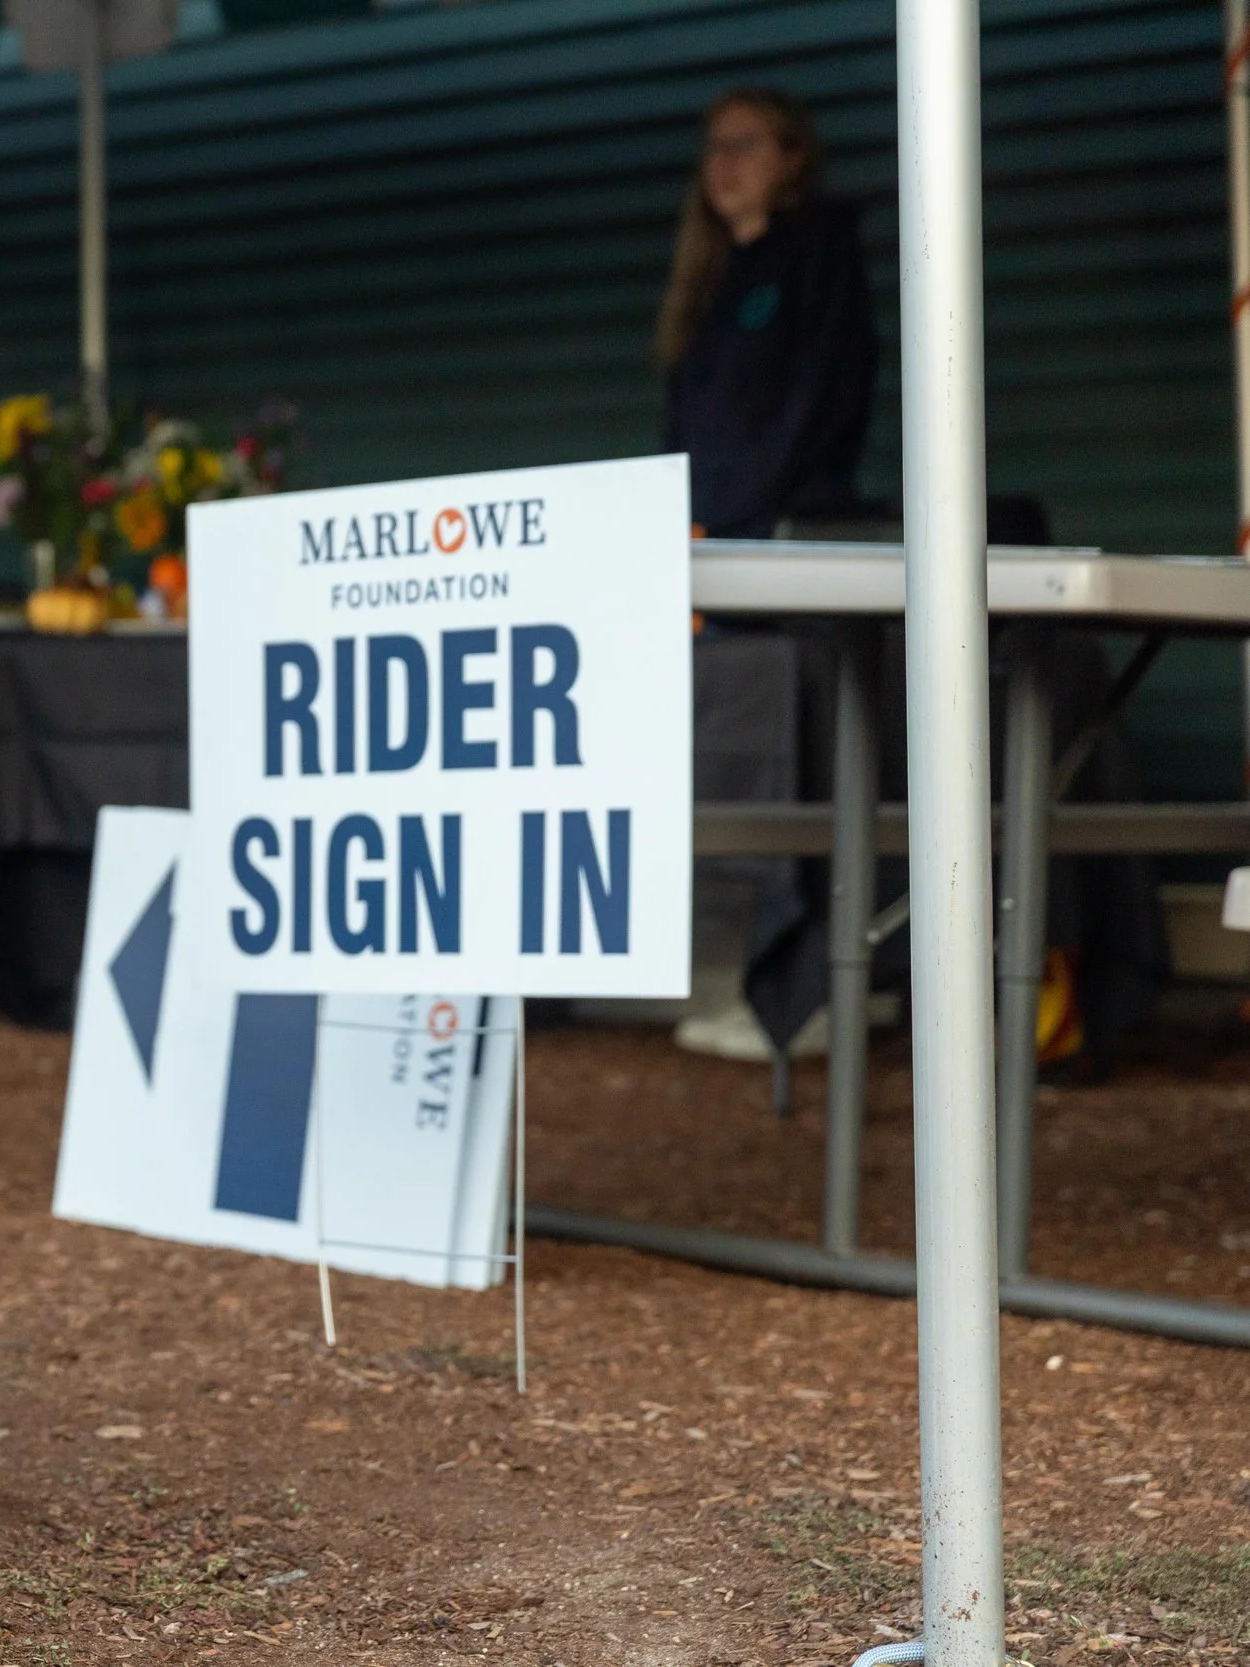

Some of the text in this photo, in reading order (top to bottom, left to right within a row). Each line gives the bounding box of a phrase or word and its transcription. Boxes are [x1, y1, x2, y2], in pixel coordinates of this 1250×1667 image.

[300, 499, 546, 565] MARLOWE
[331, 573, 510, 609] FOUNDATION
[262, 622, 584, 778] RIDER
[228, 807, 632, 957] SIGN IN
[415, 994, 459, 1131] OWE
